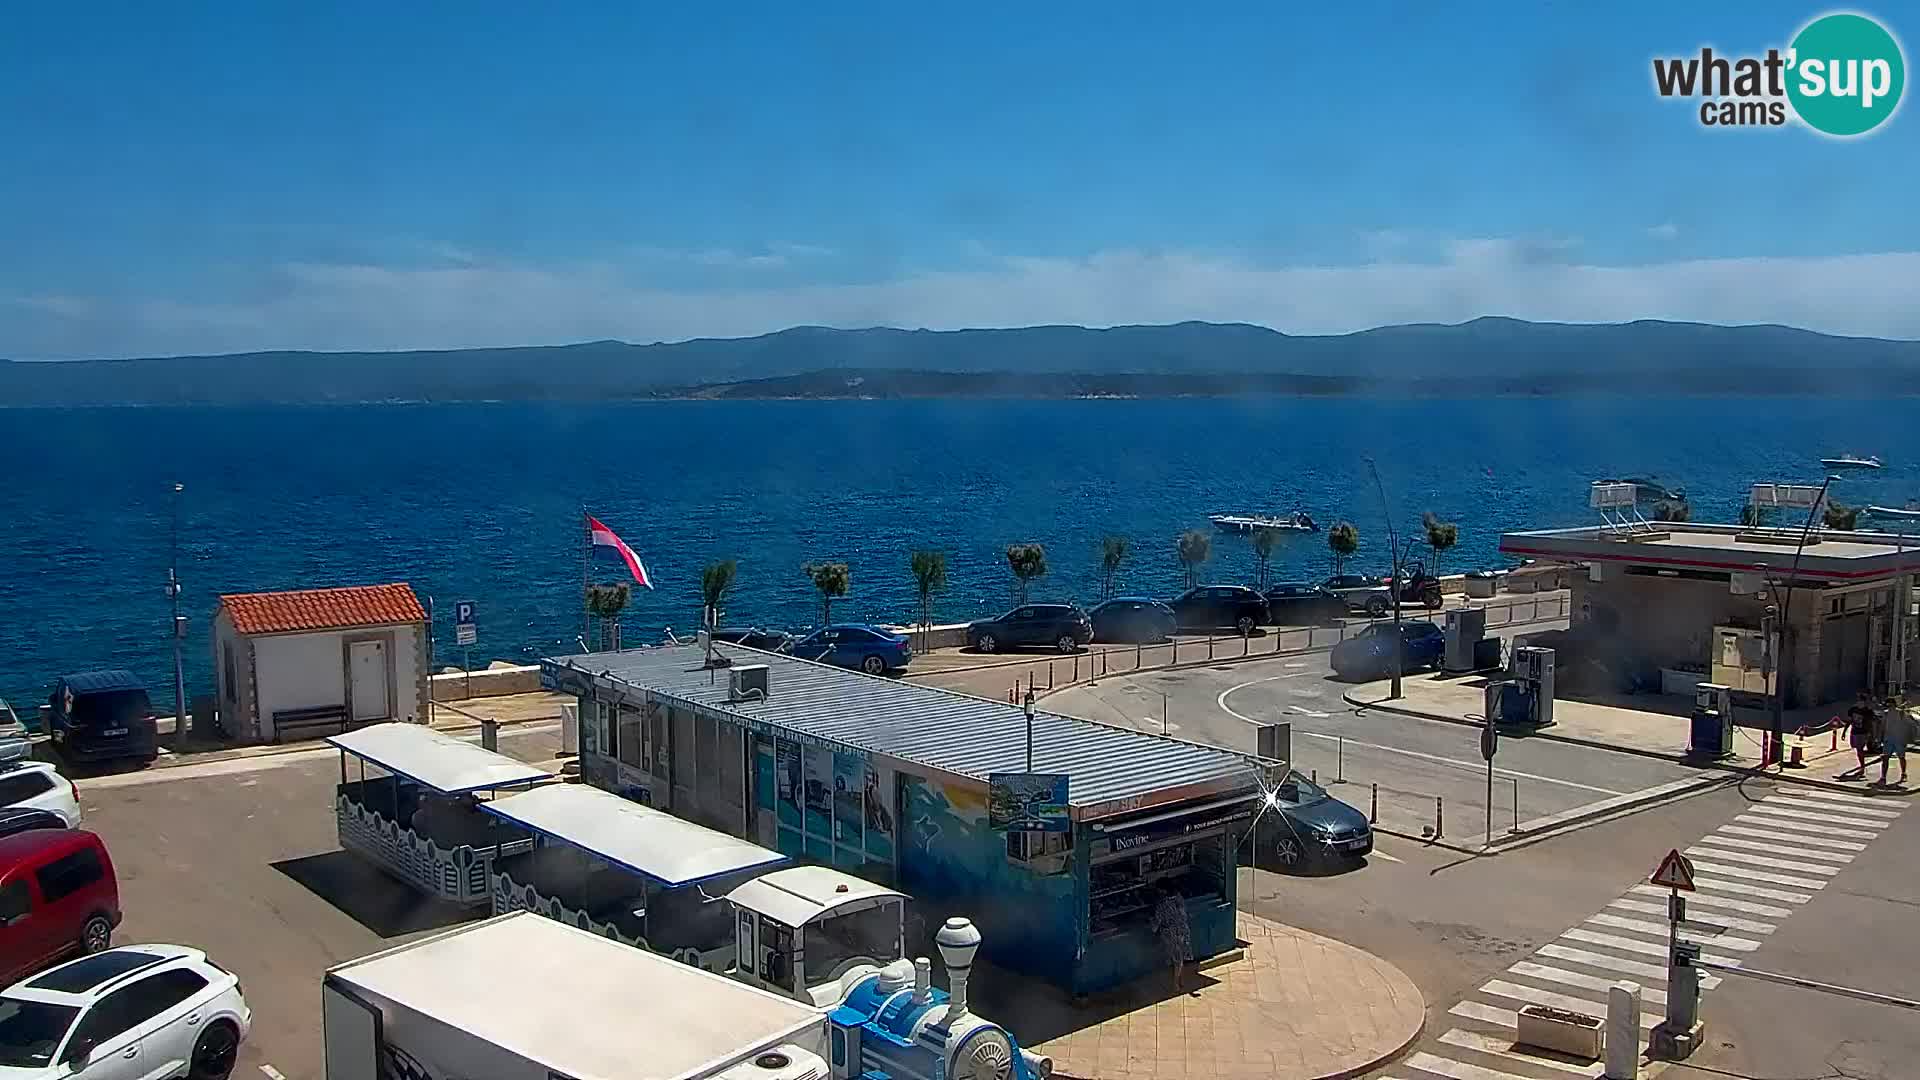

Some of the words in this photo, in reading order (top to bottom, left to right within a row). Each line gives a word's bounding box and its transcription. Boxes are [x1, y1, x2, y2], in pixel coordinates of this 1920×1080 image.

[460, 604, 471, 622] P
[785, 730, 816, 745] STATION
[820, 739, 843, 753] TICKET
[844, 745, 869, 761] OFFICE
